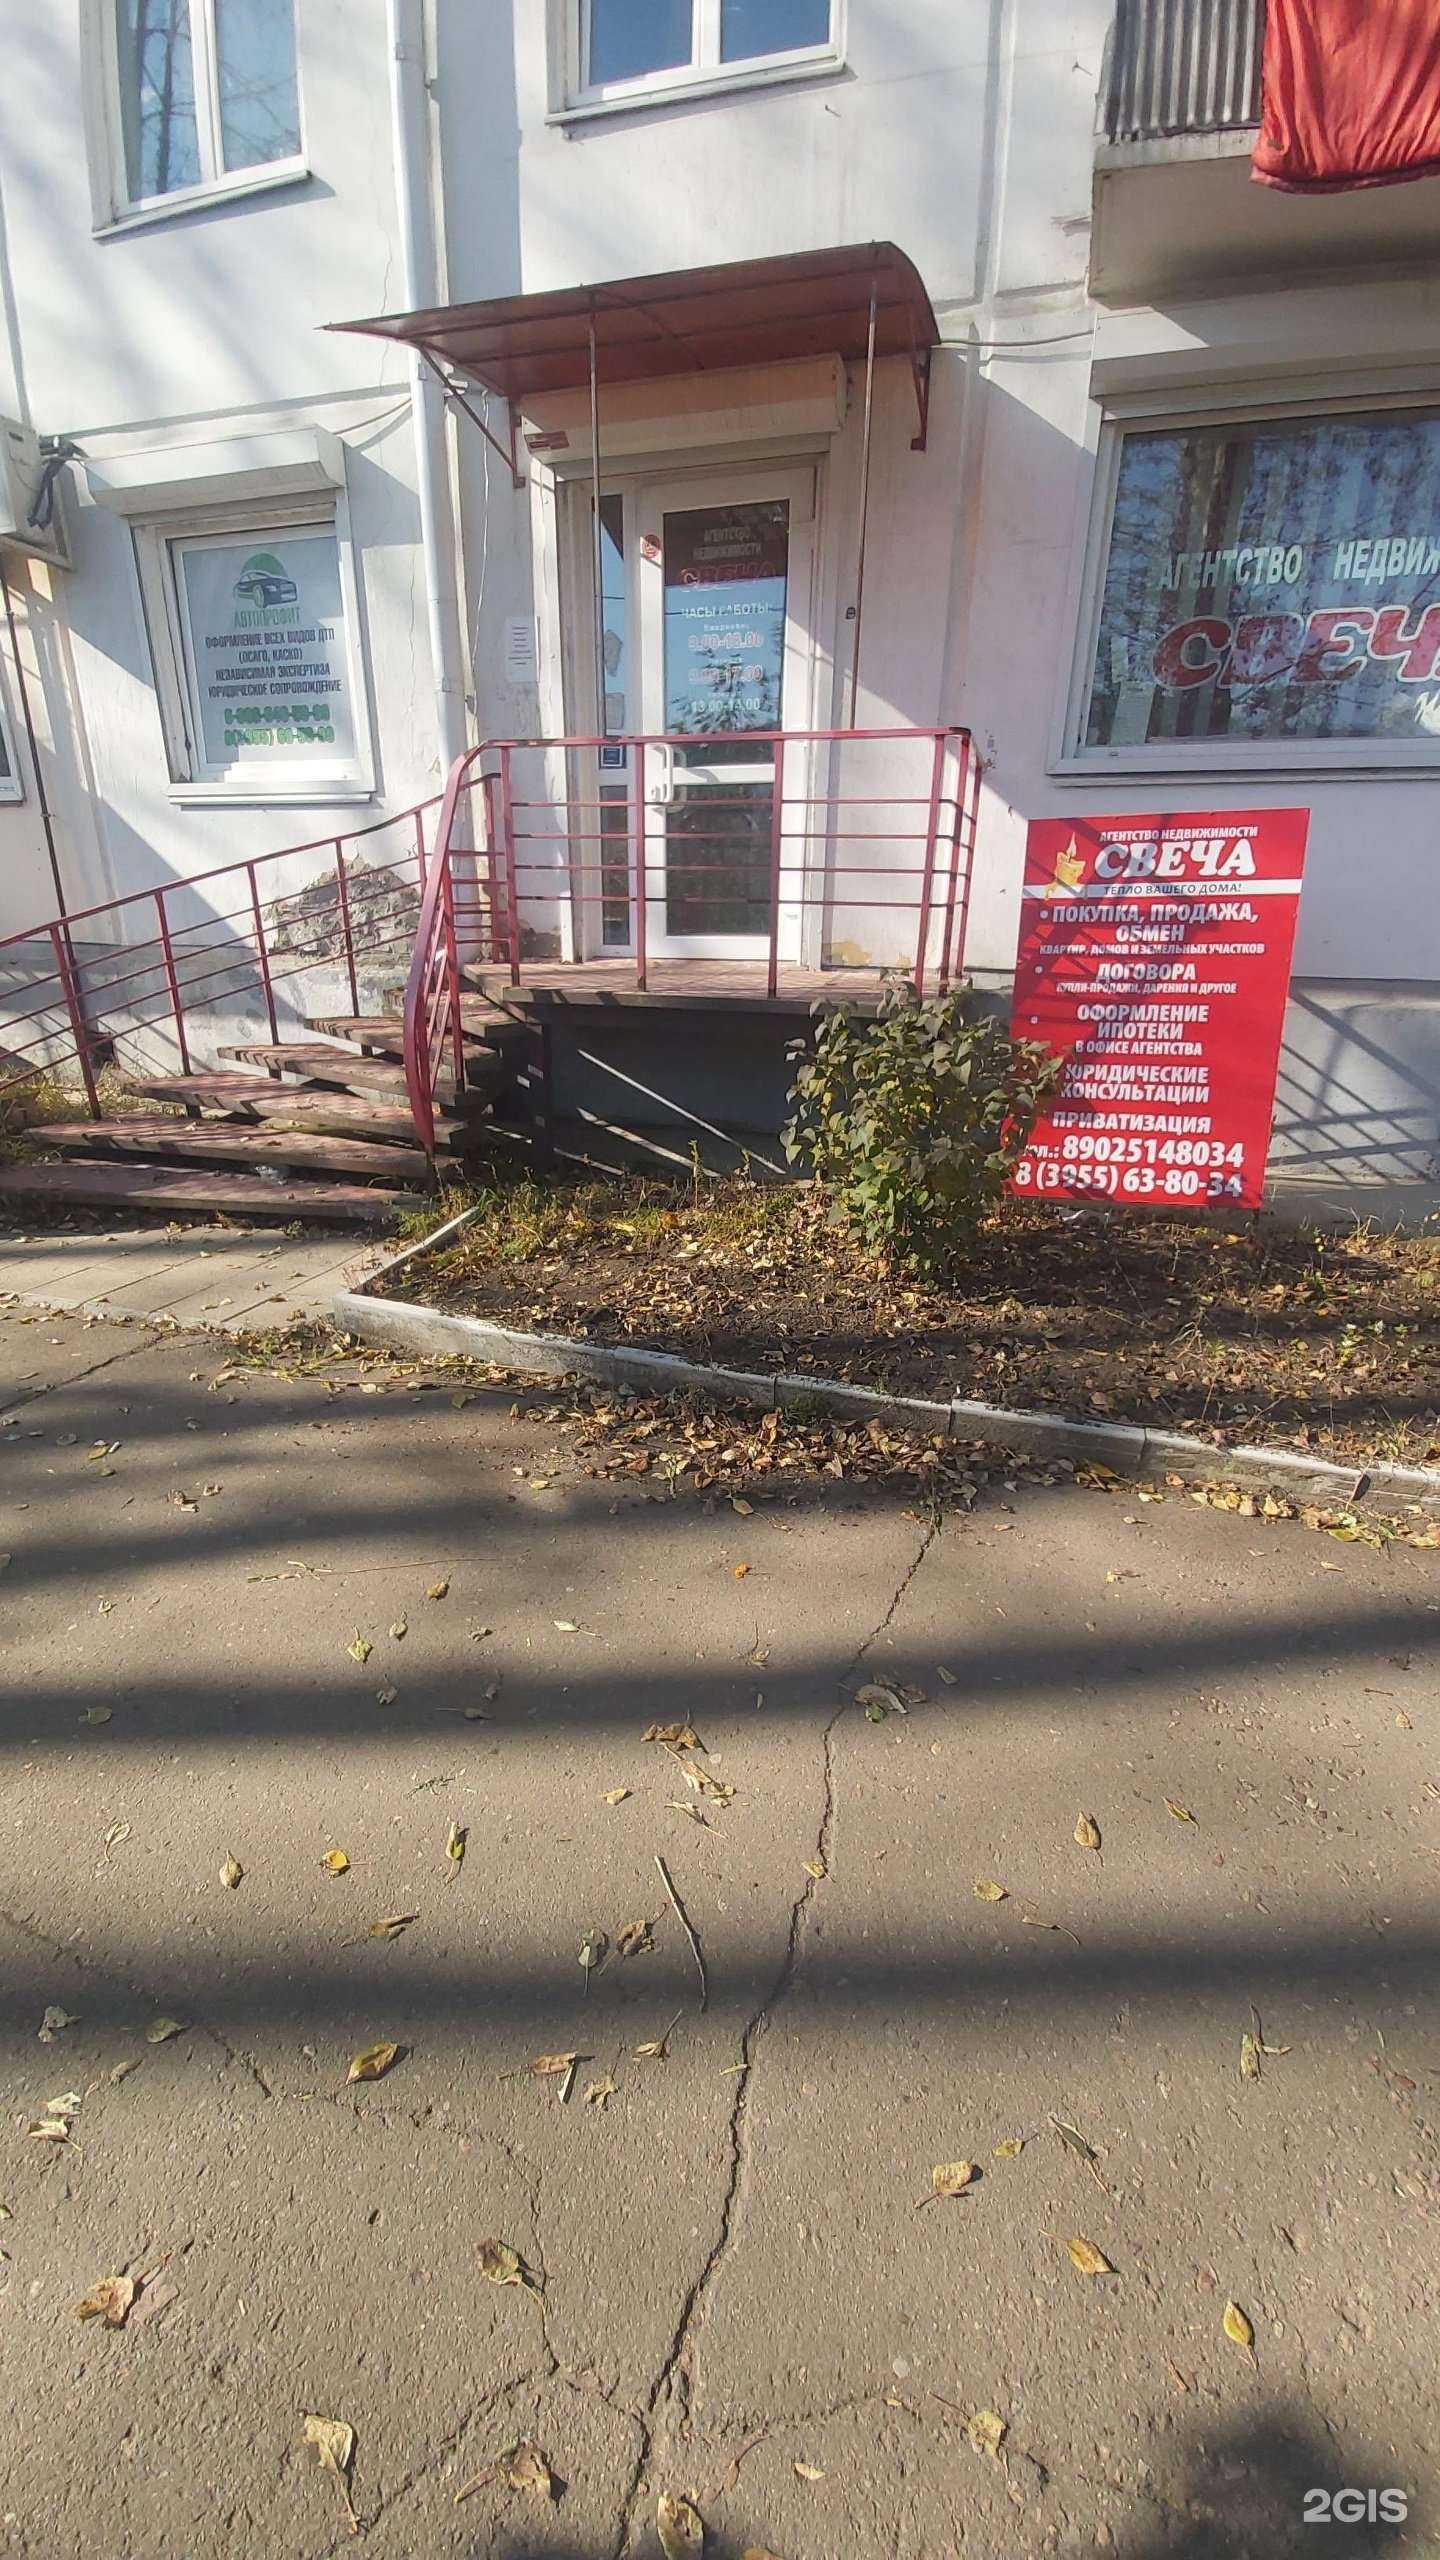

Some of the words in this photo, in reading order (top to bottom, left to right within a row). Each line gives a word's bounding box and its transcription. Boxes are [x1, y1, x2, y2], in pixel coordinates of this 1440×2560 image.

[1160, 544, 1303, 591] АГЕНТСТВО
[233, 607, 301, 628] АВТОПРОФИТ
[205, 631, 263, 649] ОФОРМЛЕНИЕ
[264, 630, 285, 645] ВСЕХ
[287, 629, 316, 644] ВИДОВ
[318, 628, 335, 643] ДТП
[1152, 603, 1440, 690] СВЕЧ
[239, 649, 271, 664] (ОСАГО,
[272, 648, 303, 662] КАСКО)
[215, 666, 276, 681] НЕЗАВИСИМАЯ
[278, 663, 331, 678] ЭКСПЕРТИЗА
[208, 683, 267, 699] ЮРИДИЧЕСКОЕ
[270, 680, 342, 695] СОПРОВОЖДЕНИЕ
[1100, 830, 1159, 842] АГЕНТСТВО
[1161, 826, 1258, 840] НЕДВИЖИМОСТИ
[1095, 838, 1256, 878] СВЕЧА
[1104, 885, 1142, 896] ТЕПЛО
[1146, 884, 1196, 895] ВАШЕГО
[1199, 882, 1242, 895] ДОМА!
[1052, 904, 1145, 923] ПОКУПКА,
[1150, 902, 1258, 923] ПРОДАЖА,
[1116, 924, 1185, 942] ОБМЕН
[1040, 944, 1088, 955] КВАРТИР,
[1090, 944, 1129, 955] ДОМОВ
[1130, 944, 1138, 955] И
[1139, 943, 1208, 955] ЗЕМЕЛЬНЫХ
[1209, 943, 1265, 954] УЧАСТКОВ
[1096, 963, 1196, 982] ДОГОВОРА
[1142, 983, 1189, 994] ДАРЕНИЯ
[1190, 983, 1198, 994] И
[1199, 983, 1236, 995] ДРУГОЕ
[1077, 1005, 1209, 1022] ОФОРМЛЕНИЕ
[1098, 1022, 1183, 1040] ИПОТЕКИ
[1075, 1041, 1083, 1053] В
[1086, 1041, 1129, 1054] ОФИСЕ
[1131, 1042, 1203, 1056] АГЕНТСТВА
[1064, 1064, 1209, 1084] ЮРИДИЧЕСКИЕ
[1061, 1082, 1209, 1105] КОНСУЛЬТАЦИИ
[1052, 1112, 1212, 1134] ПРИВАТИЗАЦИЯ
[1062, 1136, 1244, 1167] 89025148034
[1015, 1162, 1031, 1185] 8
[1037, 1162, 1118, 1193] (3955)
[1122, 1168, 1243, 1197] 63-80-34
